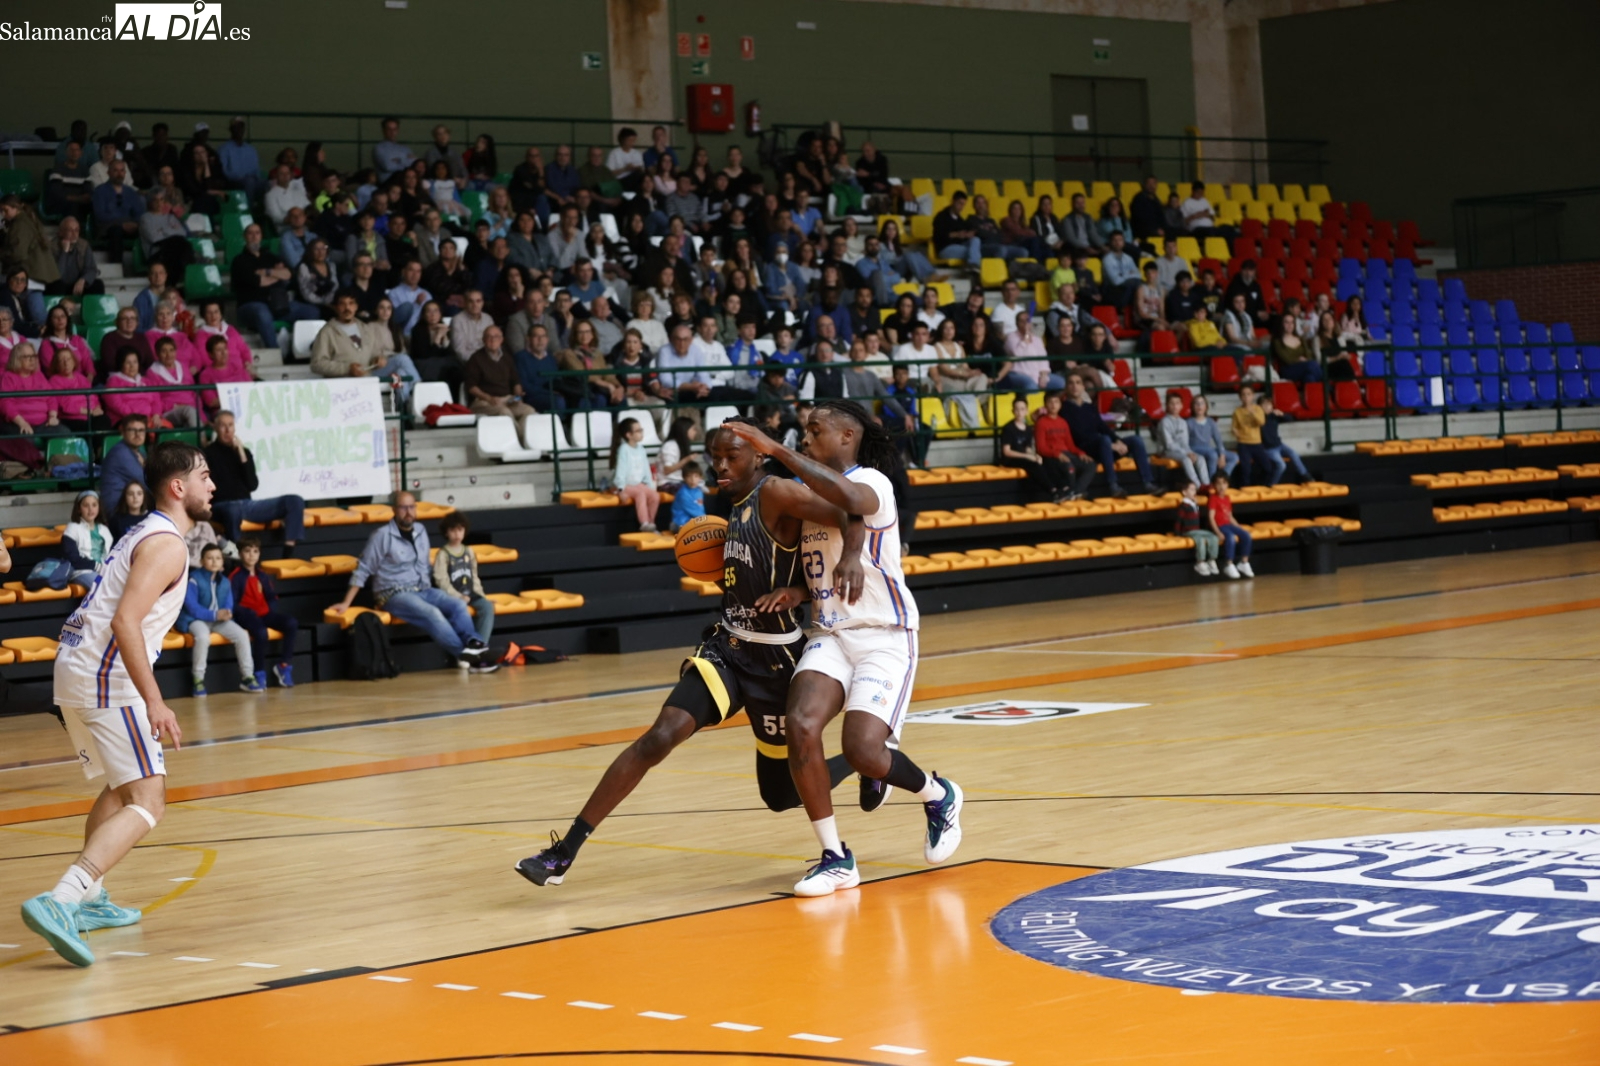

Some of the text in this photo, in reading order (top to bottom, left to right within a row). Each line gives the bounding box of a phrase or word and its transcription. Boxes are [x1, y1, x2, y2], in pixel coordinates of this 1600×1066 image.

[682, 528, 727, 545] Wilson
[724, 566, 737, 588] 55
[802, 549, 825, 579] 23
[1020, 911, 1129, 961] RENTING
[1101, 957, 1373, 994] NUEVOS
[1397, 982, 1447, 998] Y
